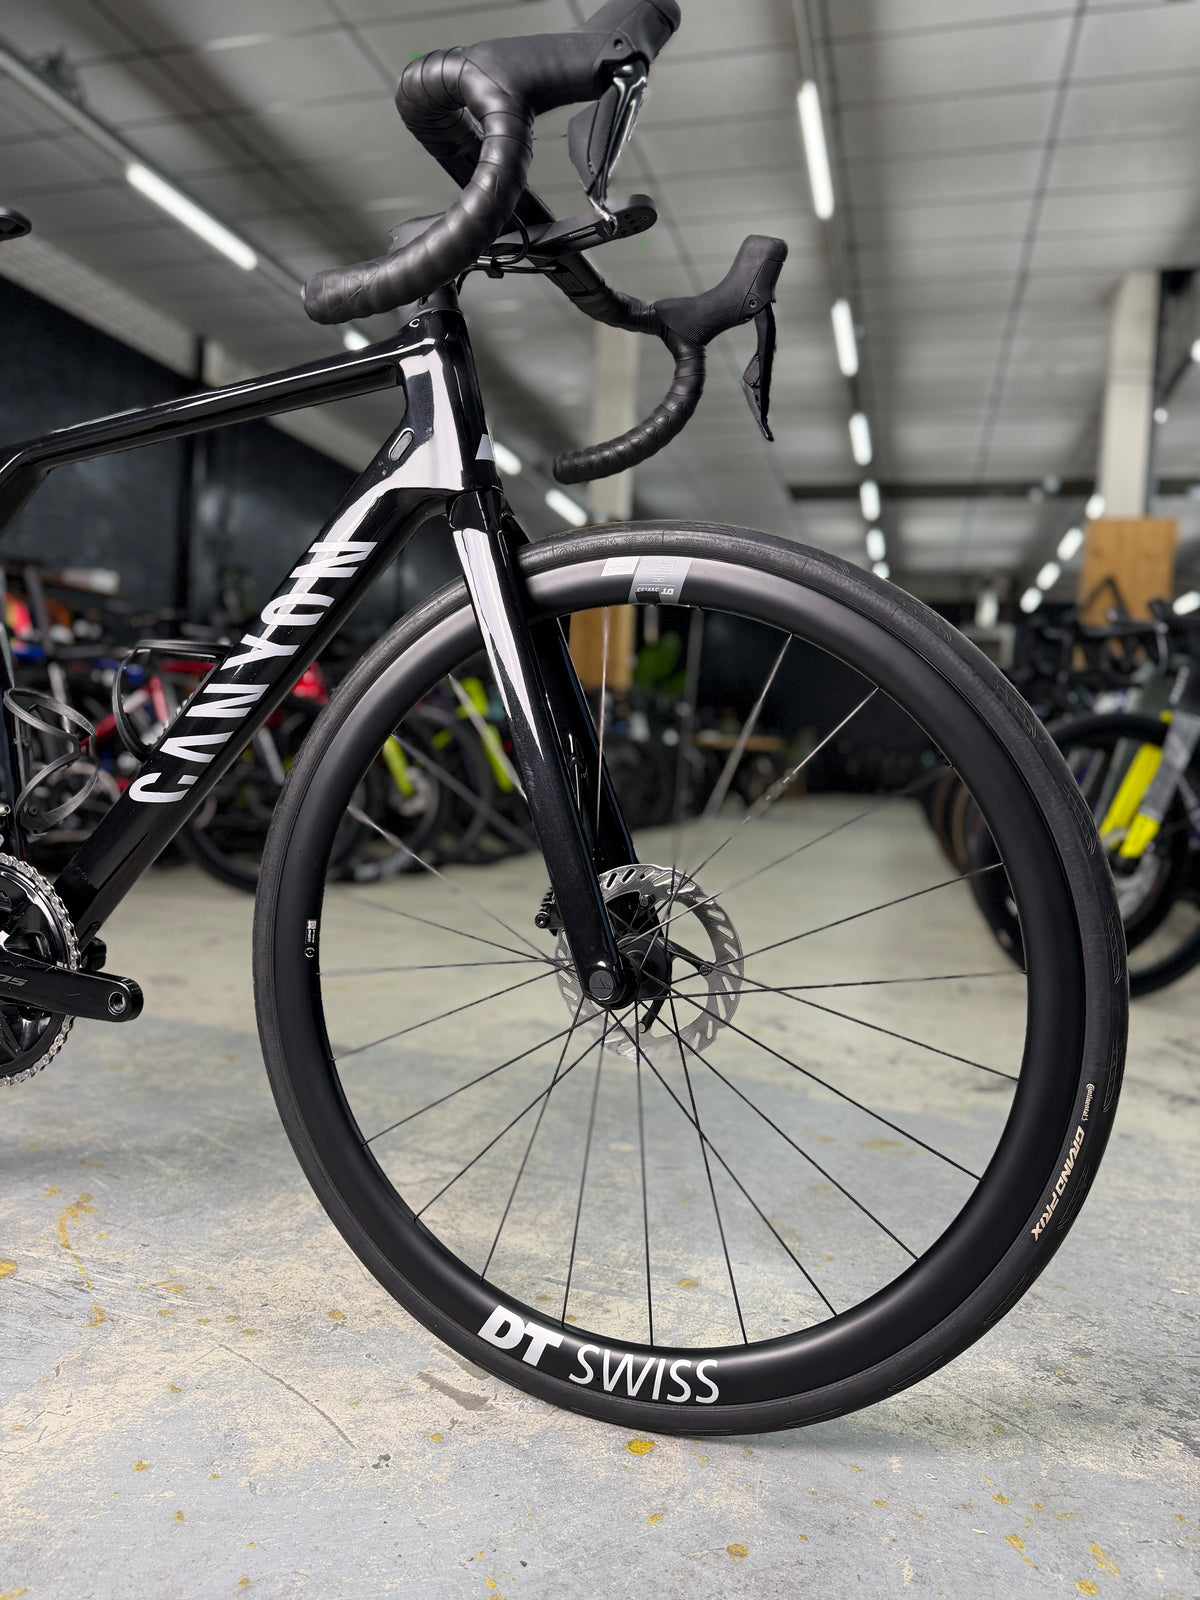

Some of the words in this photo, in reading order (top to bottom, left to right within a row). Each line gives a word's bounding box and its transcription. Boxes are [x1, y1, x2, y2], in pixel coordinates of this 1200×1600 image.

[128, 541, 378, 803] CANYON
[1084, 1083, 1095, 1117] Continental
[1055, 1125, 1085, 1195] GRAND
[1031, 1192, 1059, 1241] PRIX
[477, 1304, 564, 1366] DT
[568, 1344, 720, 1403] SWISS
